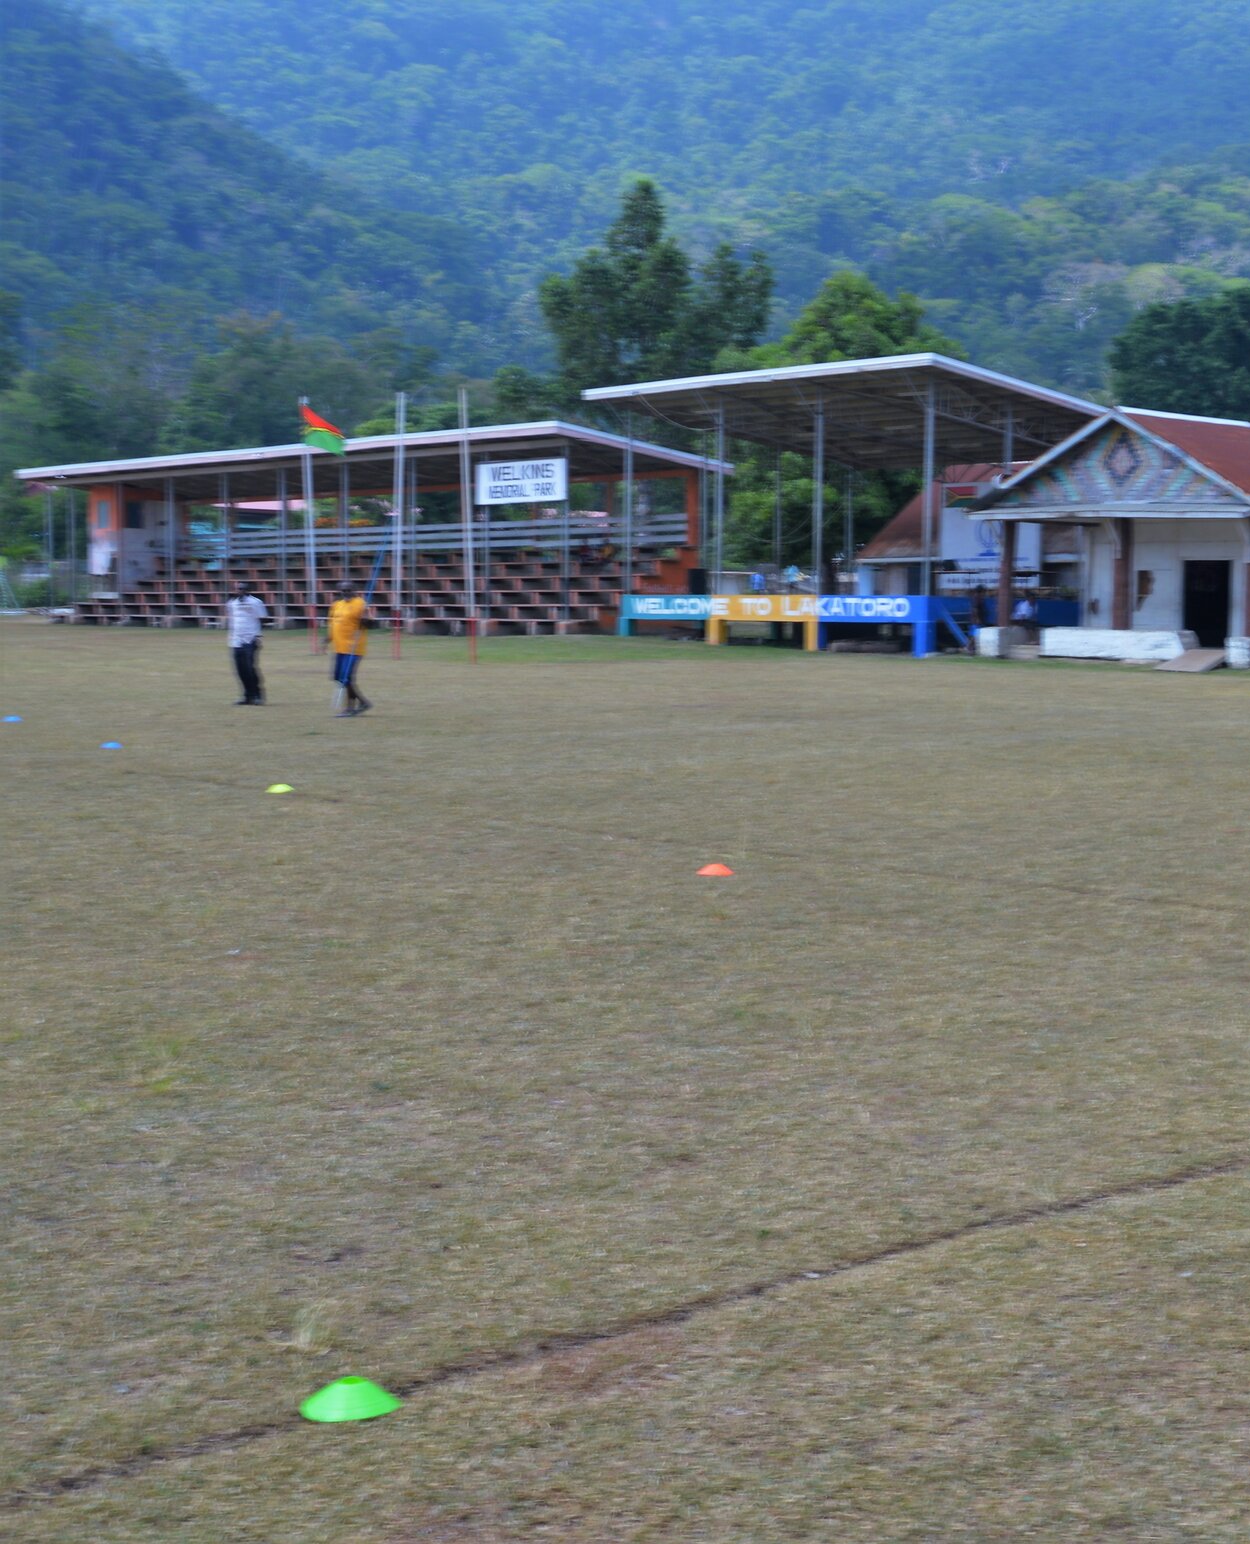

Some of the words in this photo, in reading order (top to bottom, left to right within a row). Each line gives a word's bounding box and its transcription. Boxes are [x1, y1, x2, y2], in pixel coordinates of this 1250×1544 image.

[491, 463, 554, 481] WELKINS
[533, 482, 556, 496] PARK
[632, 598, 729, 615] WELCOME
[738, 597, 772, 616] TO
[782, 597, 911, 618] LAKATORO
